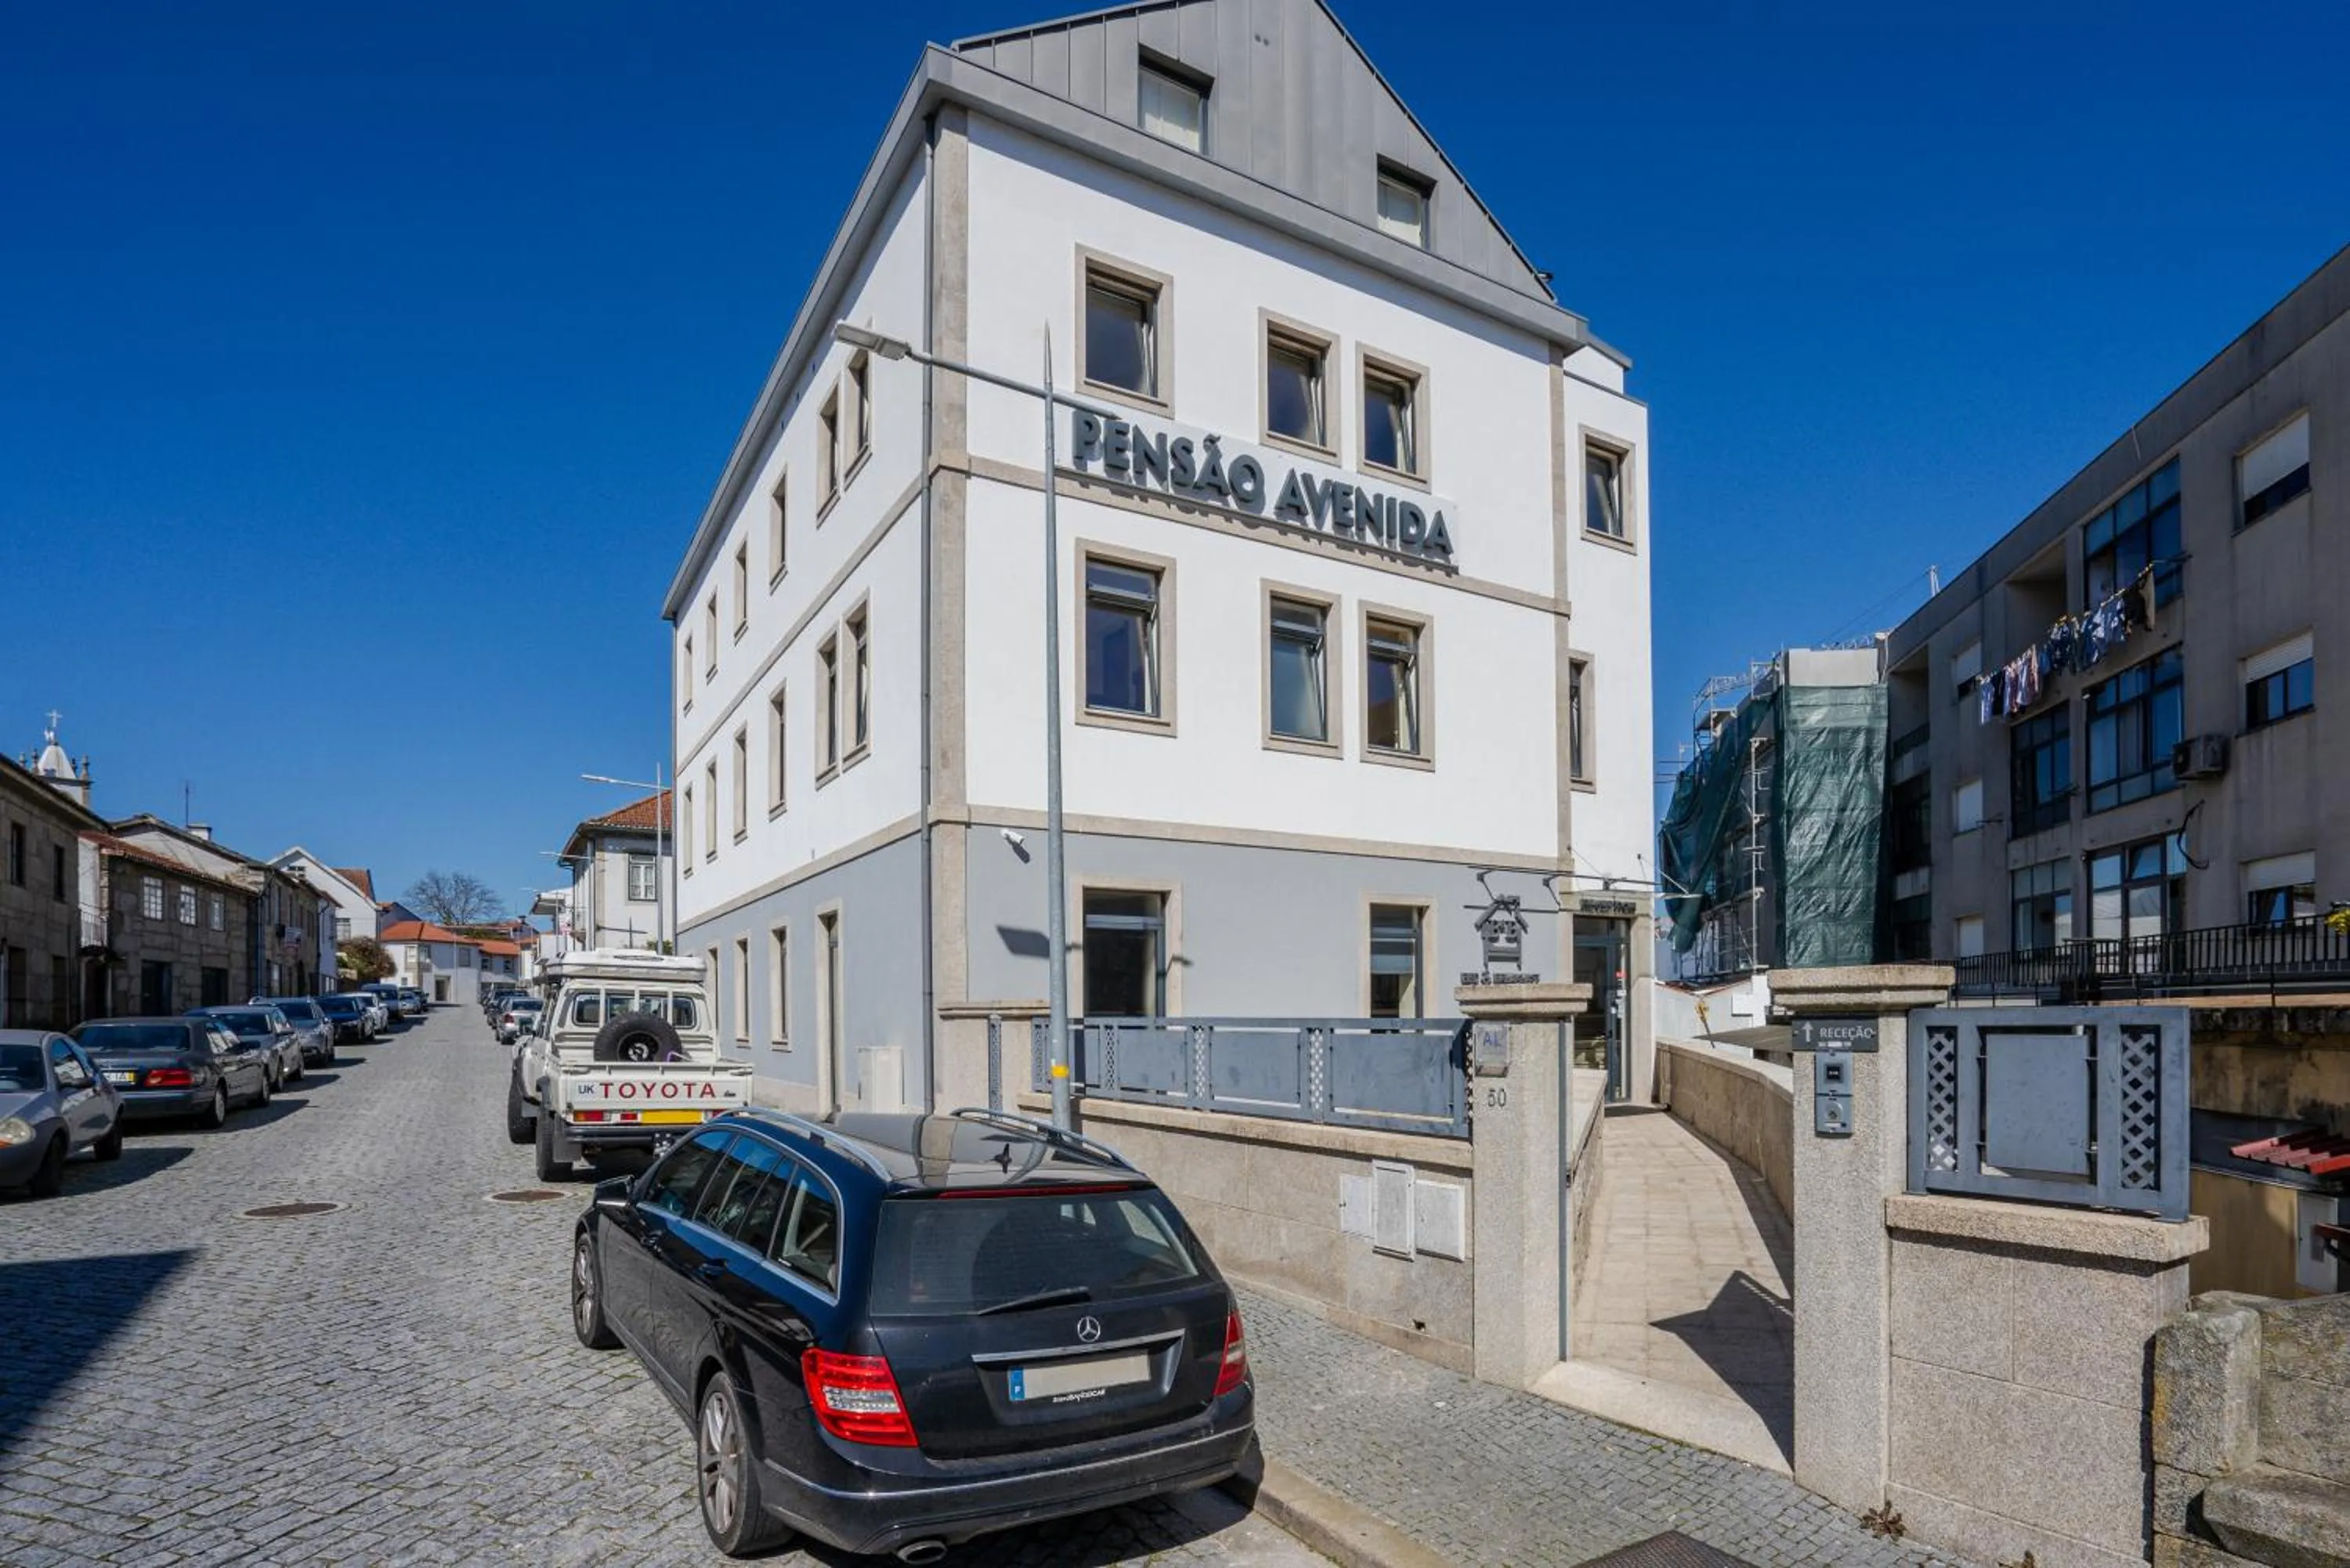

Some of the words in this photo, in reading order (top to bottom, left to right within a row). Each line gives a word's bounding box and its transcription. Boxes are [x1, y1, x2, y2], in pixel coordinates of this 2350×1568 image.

[1073, 410, 1264, 506] PENSÃO
[1275, 468, 1454, 555] AVENIDA
[1483, 1031, 1502, 1046] AL
[1820, 1025, 1873, 1040] RECEÇÃO
[578, 1085, 594, 1094] UK
[599, 1082, 715, 1098] TOYOTA
